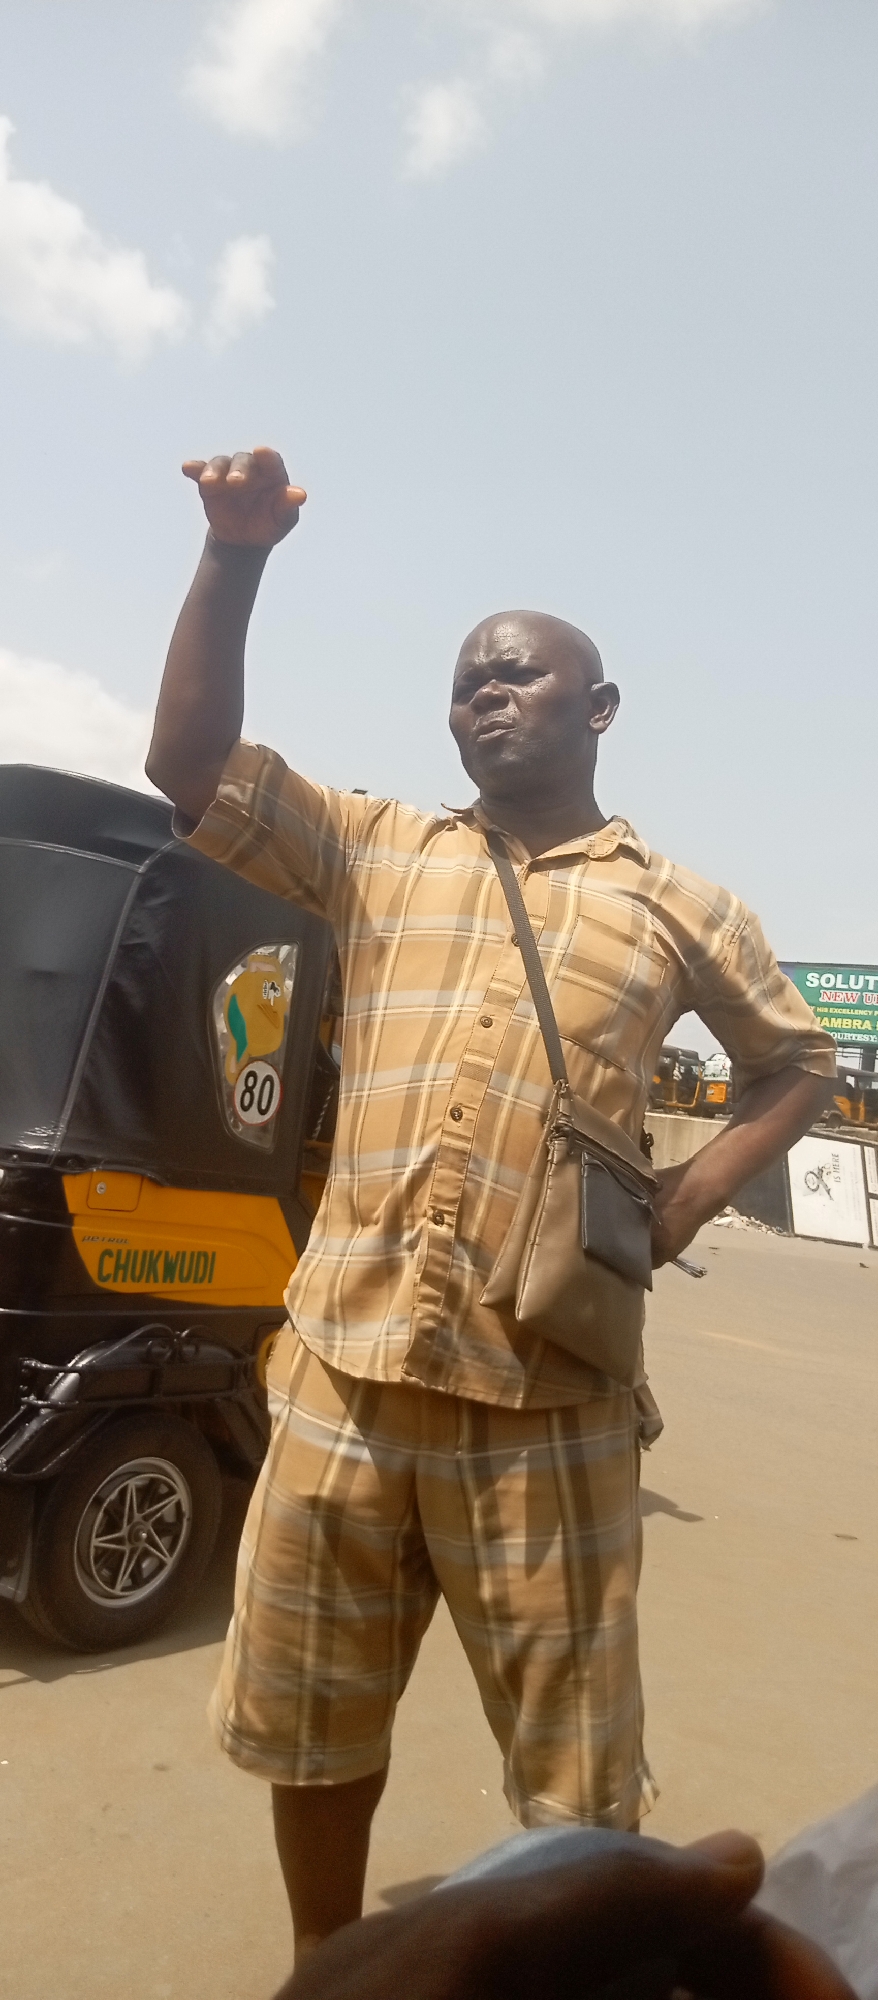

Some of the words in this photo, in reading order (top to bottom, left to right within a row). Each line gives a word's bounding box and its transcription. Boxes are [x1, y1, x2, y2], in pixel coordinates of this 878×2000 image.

[805, 972, 878, 991] SOLUT
[819, 990, 859, 1003] NEW
[829, 1008, 873, 1016] EXCELLENCY
[828, 1032, 877, 1043] OURTESY:
[240, 1070, 275, 1116] 80
[97, 1248, 217, 1284] CHUKWUDI
